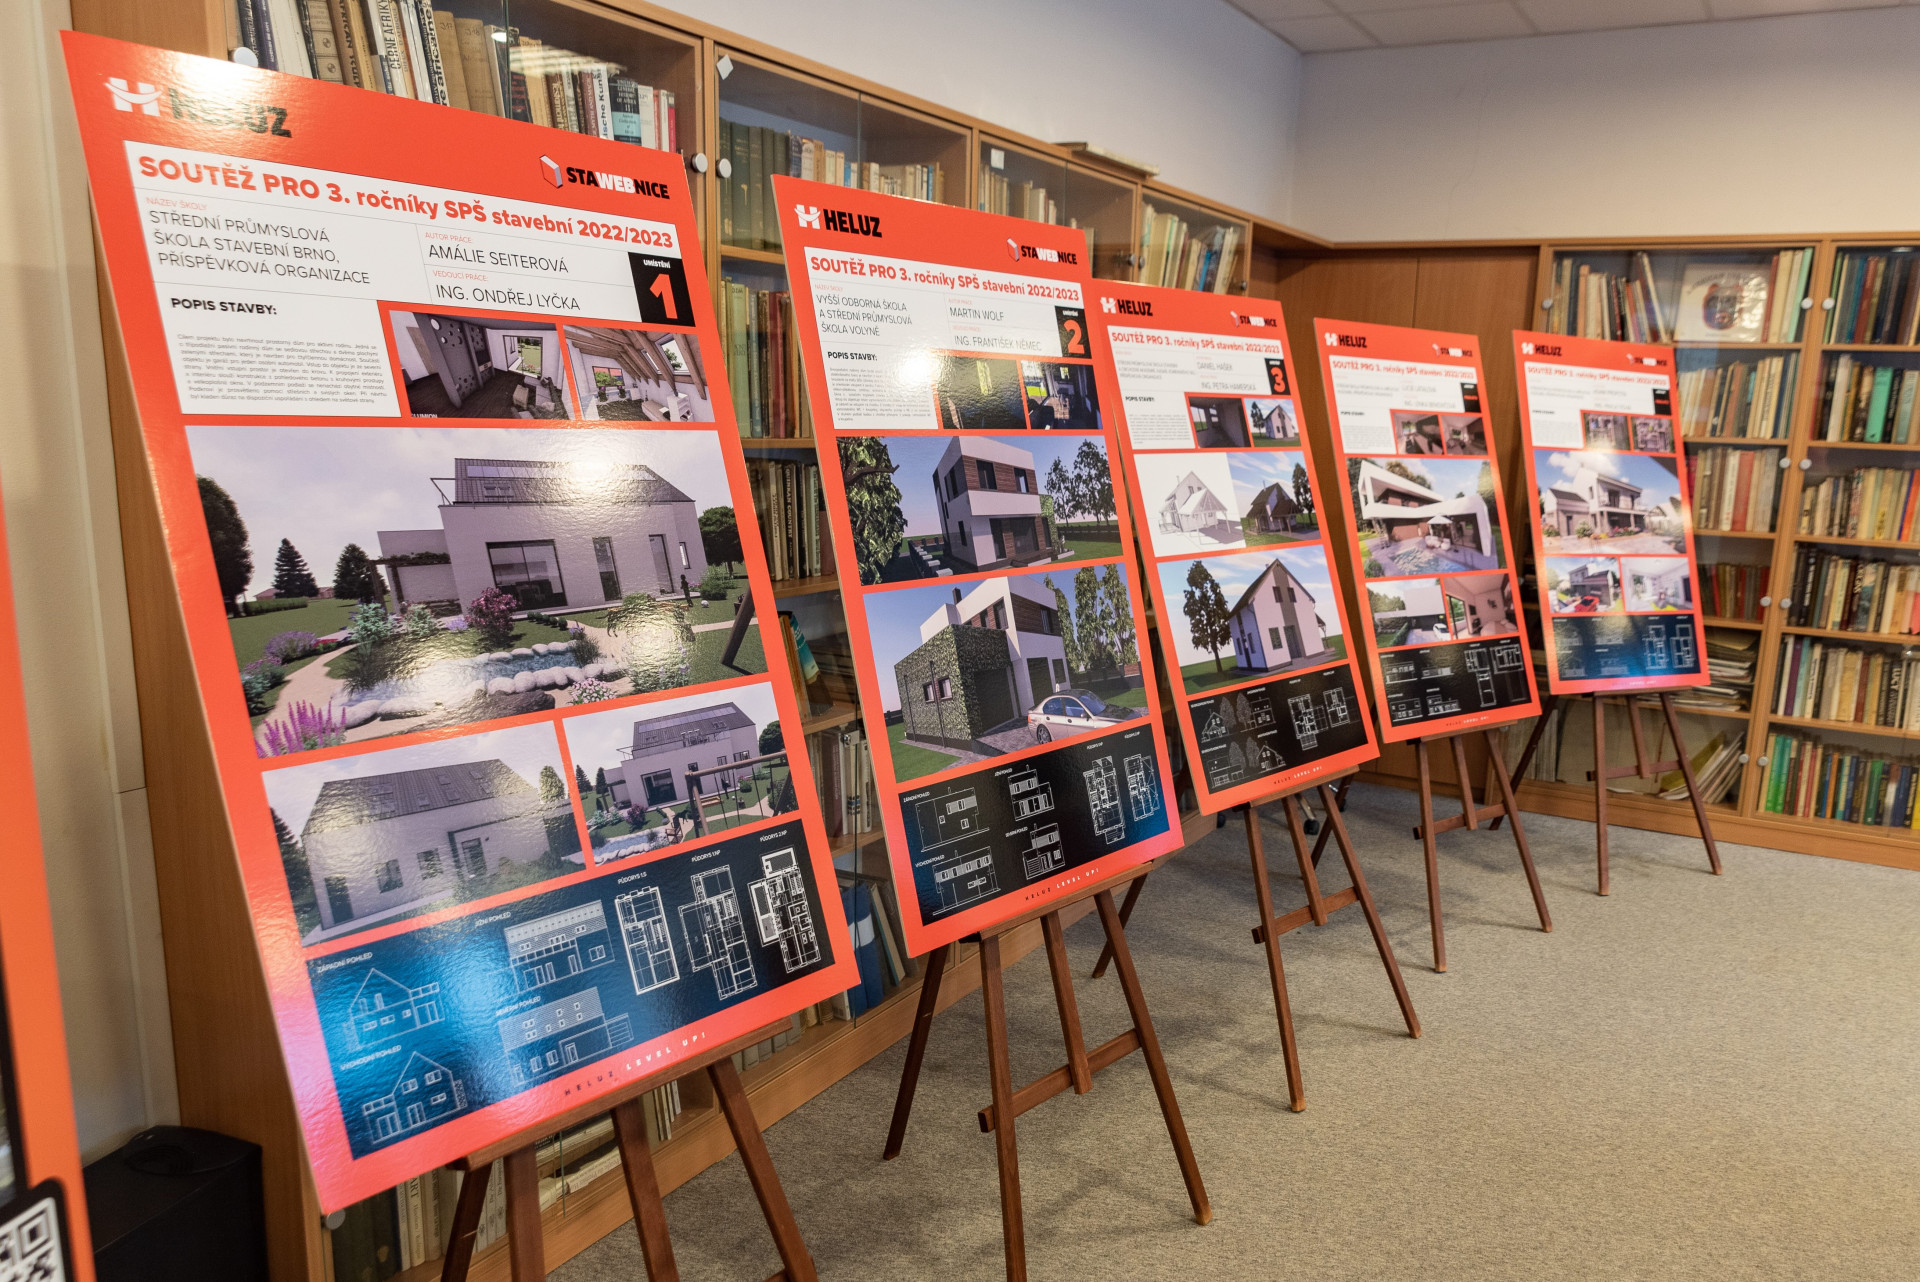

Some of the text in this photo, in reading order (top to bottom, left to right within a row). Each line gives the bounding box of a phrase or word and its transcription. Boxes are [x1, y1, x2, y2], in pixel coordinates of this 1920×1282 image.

[566, 166, 670, 200] STAWEBNICE
[139, 156, 674, 249] SOUTĚŽ PRO 3. ročníky SPŠ stavební 2022/2023
[150, 209, 330, 243] STŘEDNÍ PRŮMYSLOVÁ
[823, 208, 882, 238] HELUZ
[153, 231, 340, 264] ŠKOLA STAVEBNÍ BRNO,
[429, 244, 569, 273] AMÁLIE SEITEROVÁ
[1020, 245, 1077, 265] STAWEBNICE
[158, 252, 371, 284] PŘÍSPĚVKOVÁ ORGANIZACE
[811, 256, 1079, 302] SOUTĚŽ PRO 3. ročníky SPŠ stavební 2022/2023
[171, 297, 277, 315] POPIS STAVBY:
[436, 284, 580, 312] ING. ONDŘEJ LYČKA
[650, 273, 678, 319] 1
[817, 294, 907, 311] VYŠŠÍ ODBORNÁ ŠKOLA
[1117, 298, 1153, 317] HELUZ
[820, 309, 912, 325] A STŘEDNÍ PRŮMYSLOVÁ
[949, 307, 1004, 321] MARTIN WOLF
[1239, 315, 1277, 328] STANICE
[821, 323, 847, 334] ŠKOLA
[954, 336, 970, 346] ING.
[972, 336, 1014, 349] FRANTIŠEK
[1063, 319, 1085, 354] 2
[1111, 332, 1144, 345] SOUTĚŽ
[1146, 334, 1163, 345] PRO
[1165, 336, 1172, 346] 3.
[1174, 337, 1200, 349] ročníky
[1201, 337, 1215, 349] SPŠ
[1338, 334, 1367, 348] HELUZ
[827, 351, 878, 362] POPIS STAVBY:
[1270, 366, 1286, 394] 3
[565, 1031, 706, 1095] HELUZ LEVEL UP!
